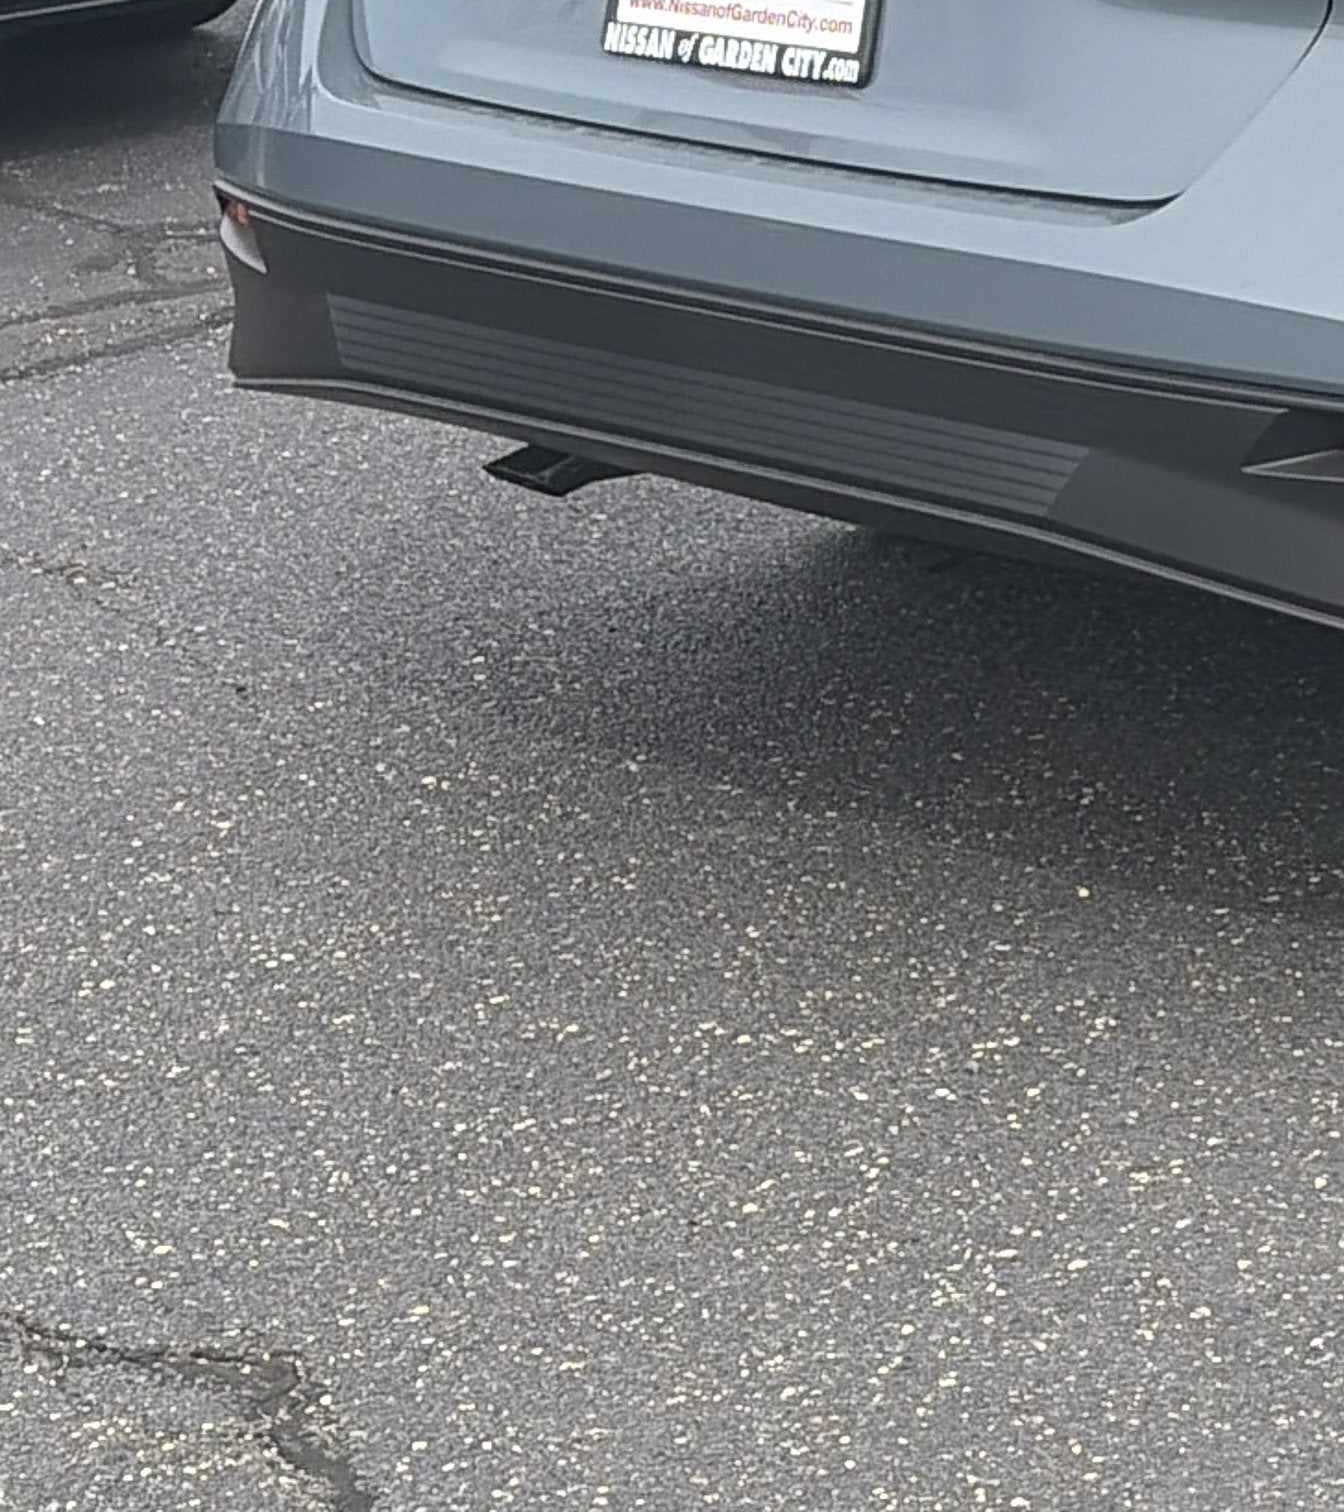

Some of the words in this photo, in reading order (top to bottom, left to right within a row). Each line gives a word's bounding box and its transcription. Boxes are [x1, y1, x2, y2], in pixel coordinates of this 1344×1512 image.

[603, 21, 677, 61] NISSAN
[677, 32, 700, 64] of
[699, 35, 779, 75] GARDEN
